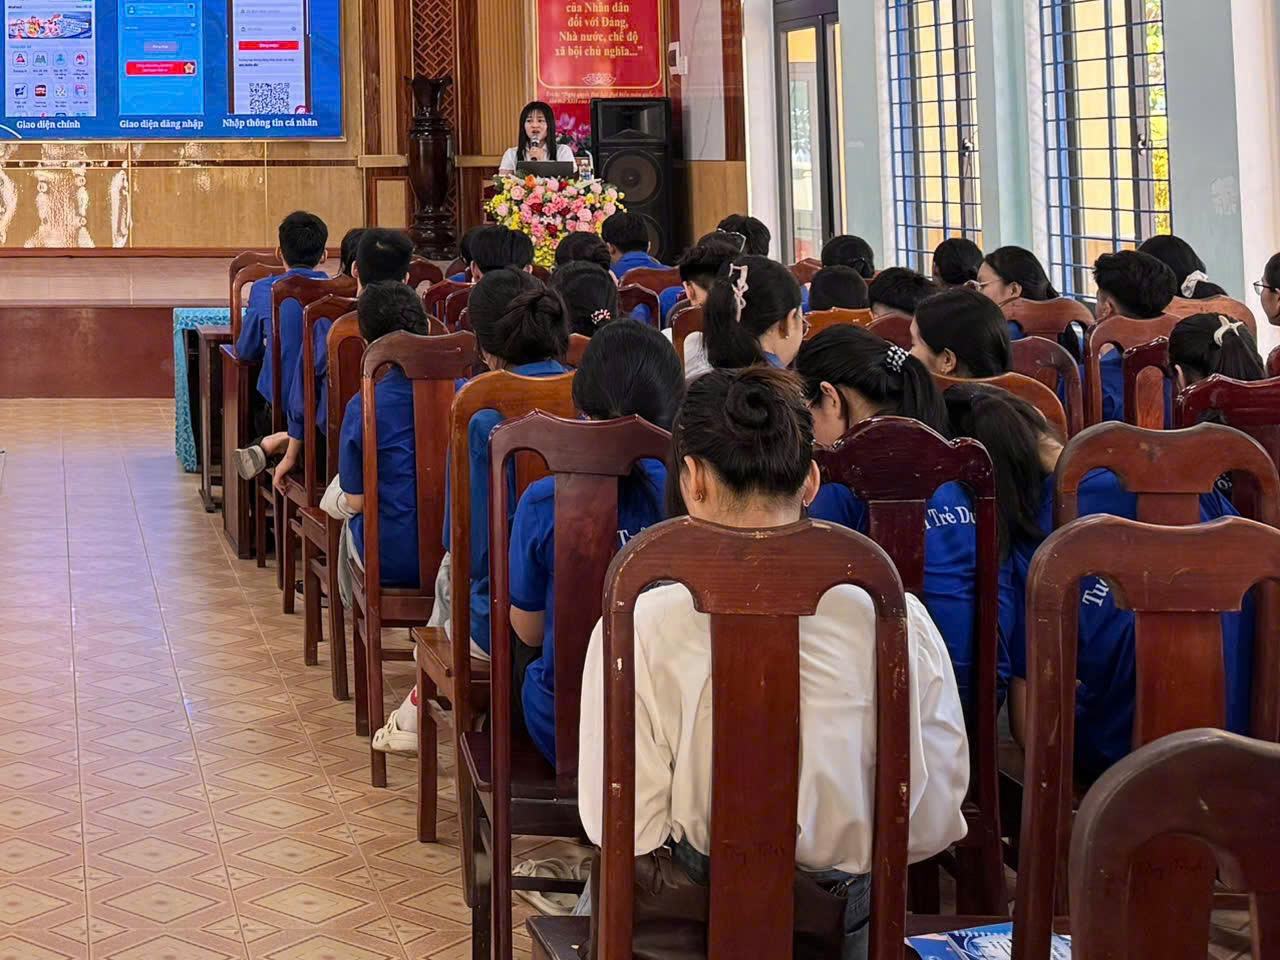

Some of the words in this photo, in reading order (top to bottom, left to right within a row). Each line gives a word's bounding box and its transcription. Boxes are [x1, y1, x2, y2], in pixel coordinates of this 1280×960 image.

[17, 120, 35, 128] Giao
[37, 120, 55, 130] diện
[57, 120, 80, 128] chính
[120, 119, 139, 128] Giao
[141, 119, 158, 129] diện
[160, 119, 180, 129] đăng
[182, 119, 204, 129] nhập
[223, 119, 244, 129] Nhập
[246, 118, 270, 129] thông
[272, 119, 283, 127] tin
[285, 118, 295, 127] cá
[296, 118, 318, 127] nhân
[928, 506, 956, 526] Trẻ
